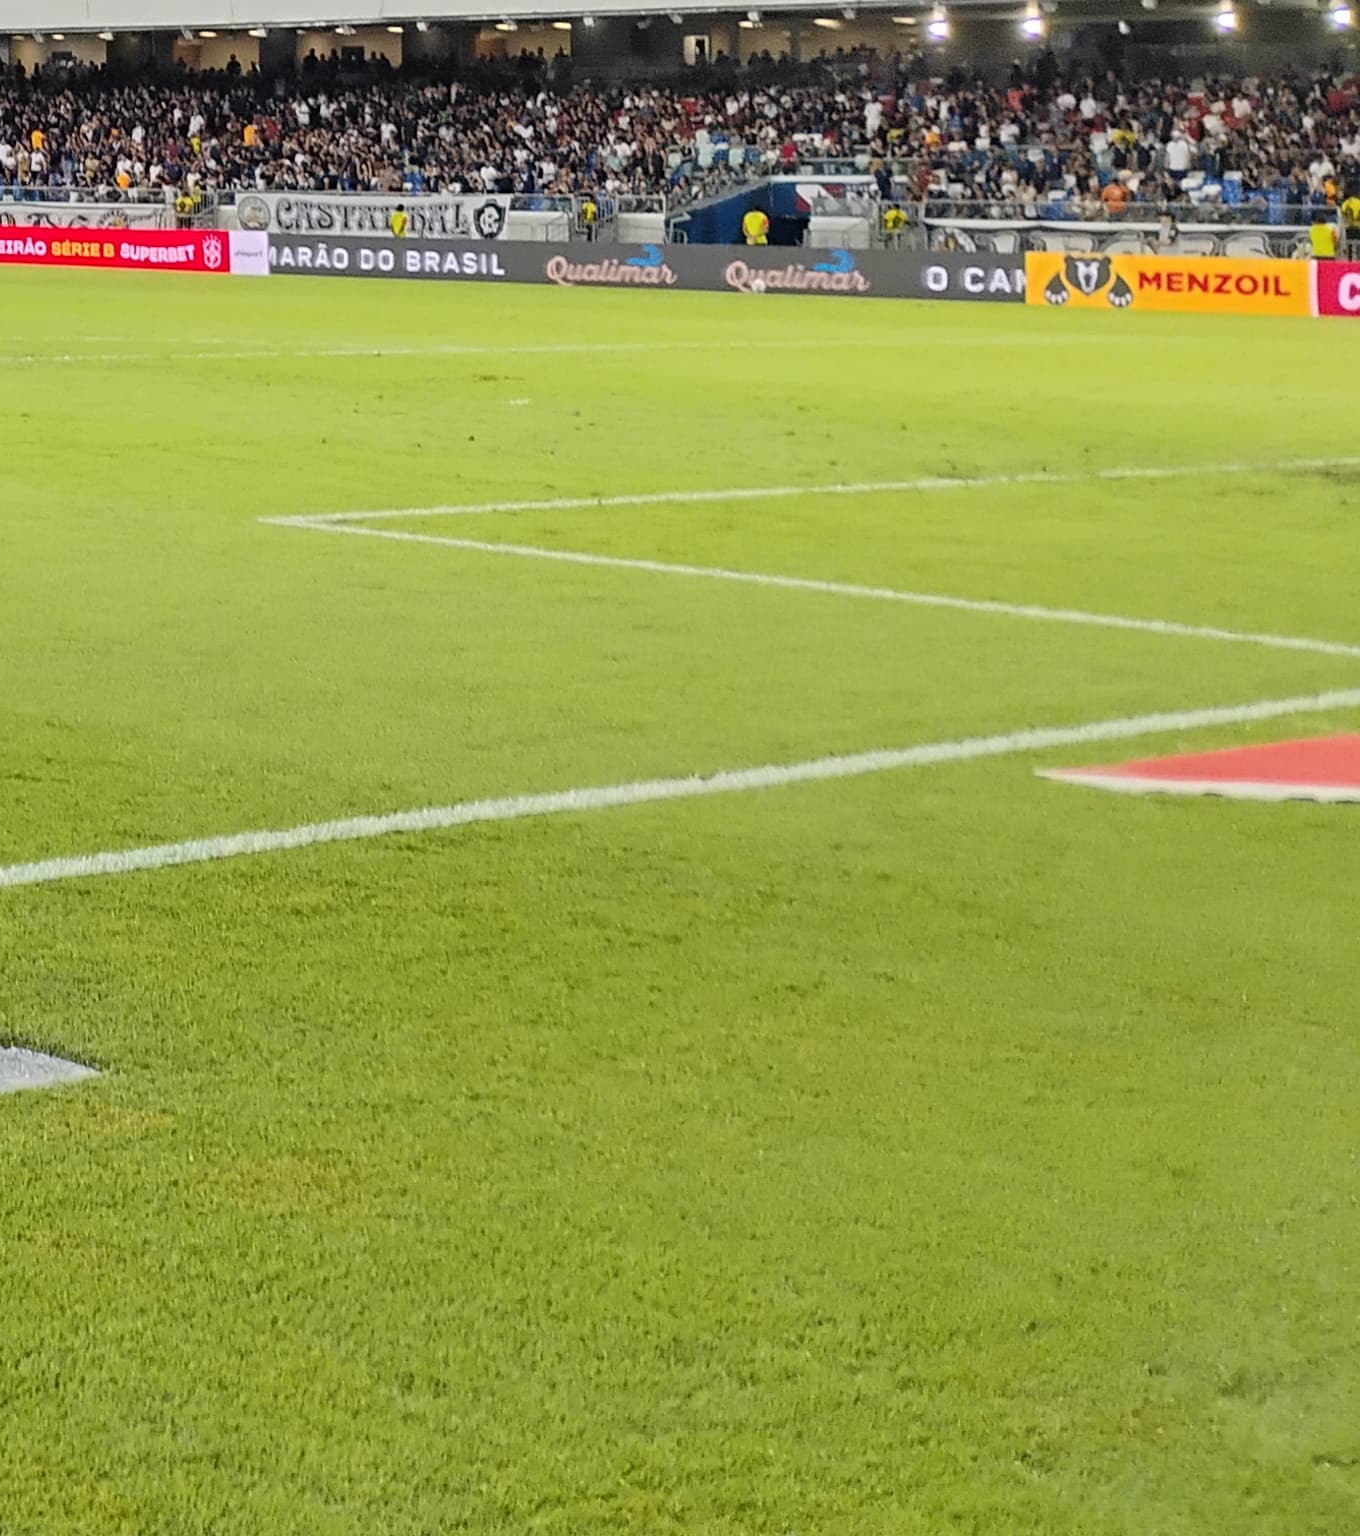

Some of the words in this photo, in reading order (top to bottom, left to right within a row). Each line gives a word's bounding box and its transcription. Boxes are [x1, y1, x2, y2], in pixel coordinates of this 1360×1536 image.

[51, 240, 101, 257] SÉRIE
[103, 243, 115, 257] B
[119, 242, 195, 263] SUPERBET
[360, 249, 394, 271] DO
[405, 250, 506, 277] BRASIL
[546, 255, 679, 286] Qualimar
[725, 260, 871, 293] Qualimar
[927, 267, 949, 292] O
[1138, 271, 1292, 297] MENZOIL
